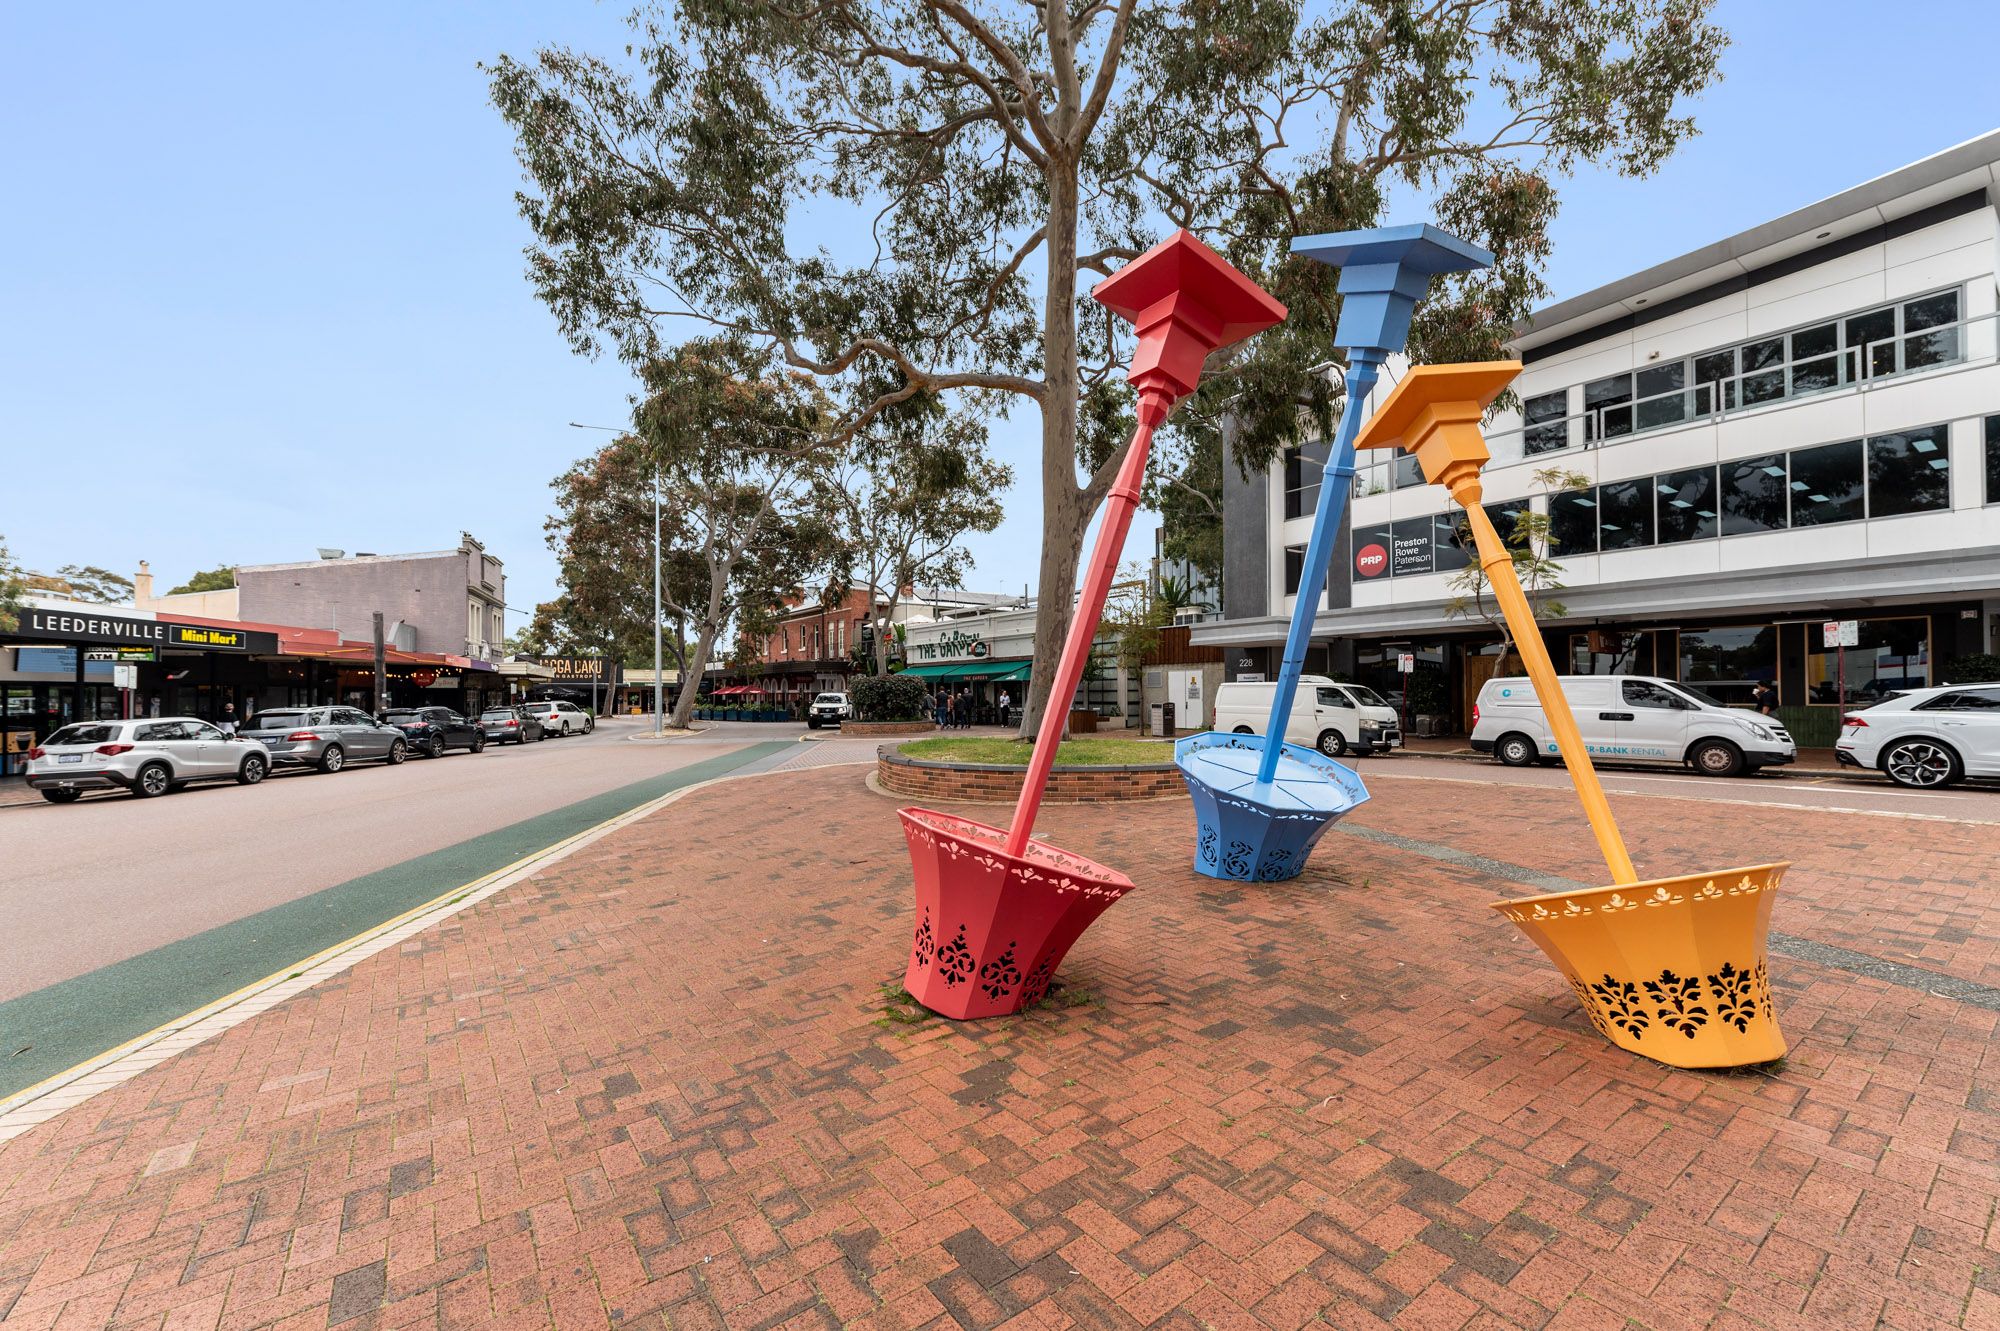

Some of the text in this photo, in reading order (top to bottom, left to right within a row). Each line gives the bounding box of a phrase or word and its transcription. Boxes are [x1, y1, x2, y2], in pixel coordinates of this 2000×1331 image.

[1395, 537, 1428, 549] Preston
[1395, 547, 1419, 557] Rowe
[1360, 555, 1383, 566] PRP
[1395, 554, 1431, 565] Paterson
[33, 614, 164, 639] LEEDERVILLE
[181, 628, 237, 645] Mini Mart
[917, 644, 937, 659] THE
[574, 659, 602, 674] DAKU
[1239, 658, 1254, 667] 228
[1631, 747, 1667, 756] RENTAL
